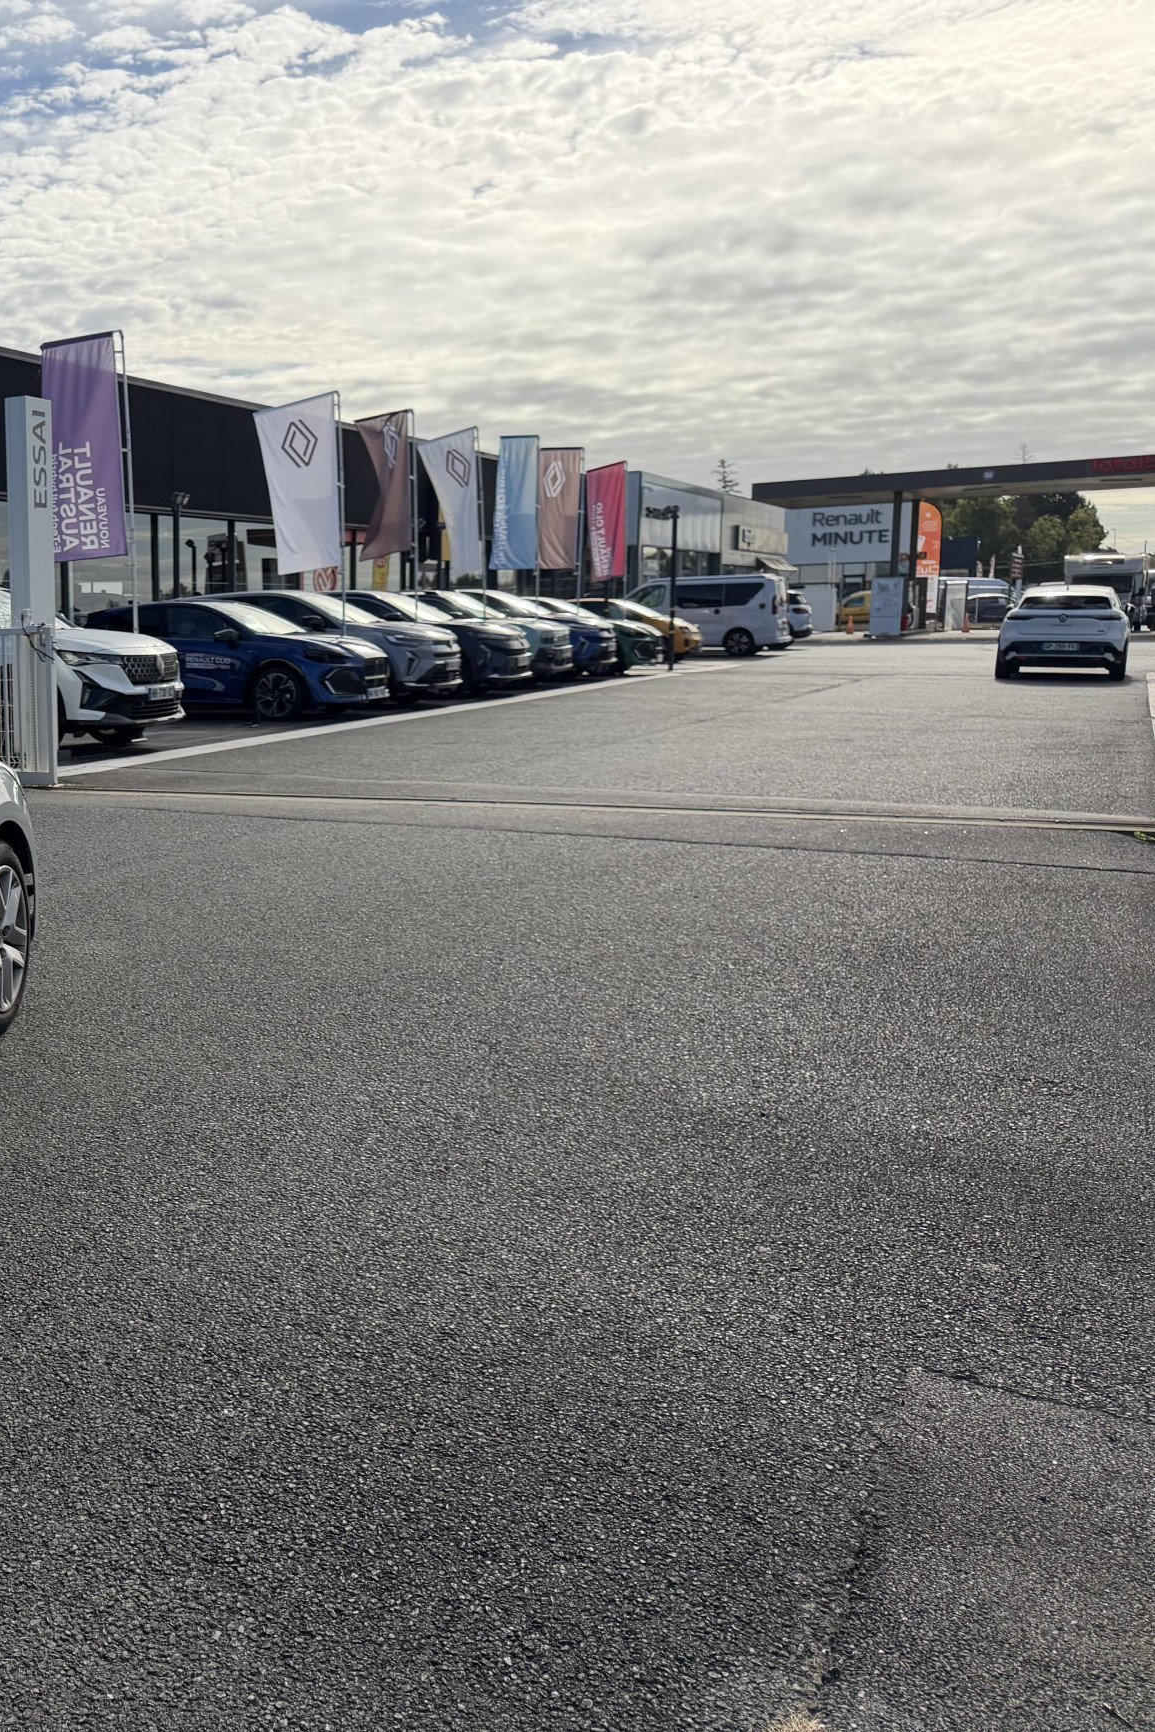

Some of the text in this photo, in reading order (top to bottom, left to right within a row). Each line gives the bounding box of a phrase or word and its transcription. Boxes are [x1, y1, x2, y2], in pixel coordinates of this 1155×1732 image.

[32, 409, 47, 509] ESSAI
[812, 508, 883, 527] Renault
[811, 529, 890, 547] MINUTE
